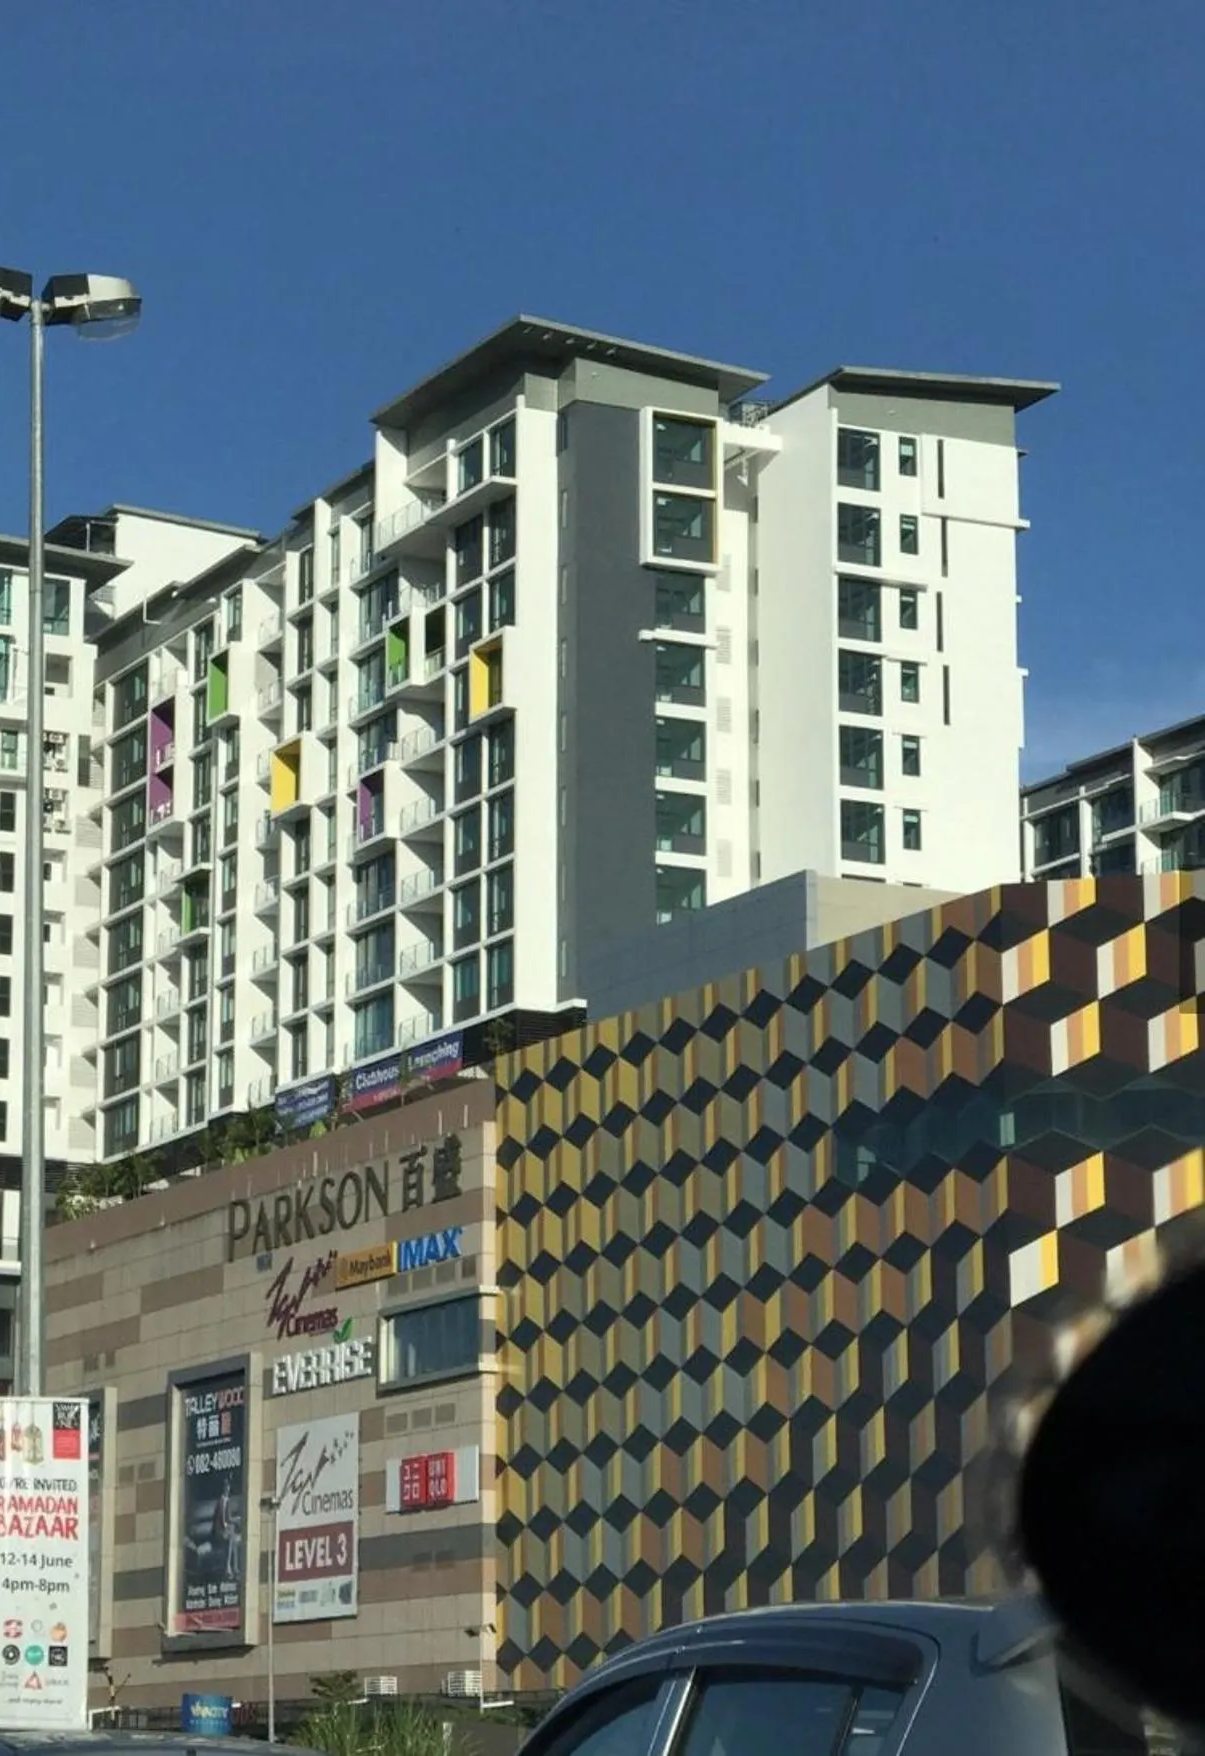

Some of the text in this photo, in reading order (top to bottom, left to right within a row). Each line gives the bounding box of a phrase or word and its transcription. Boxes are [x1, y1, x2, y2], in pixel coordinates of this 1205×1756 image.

[228, 1160, 389, 1263] PARKSON
[399, 1226, 464, 1272] IMAX
[286, 1307, 339, 1338] Cinemas
[272, 1335, 372, 1395] EVERRISE
[428, 1459, 446, 1477] UNI
[33, 1478, 78, 1492] INVITED
[428, 1478, 447, 1499] QLO
[301, 1489, 354, 1516] Cinemas
[0, 1552, 74, 1569] 12-14 June
[284, 1533, 348, 1572] LEVEL 3
[1, 1578, 71, 1595] 4pm-8pm
